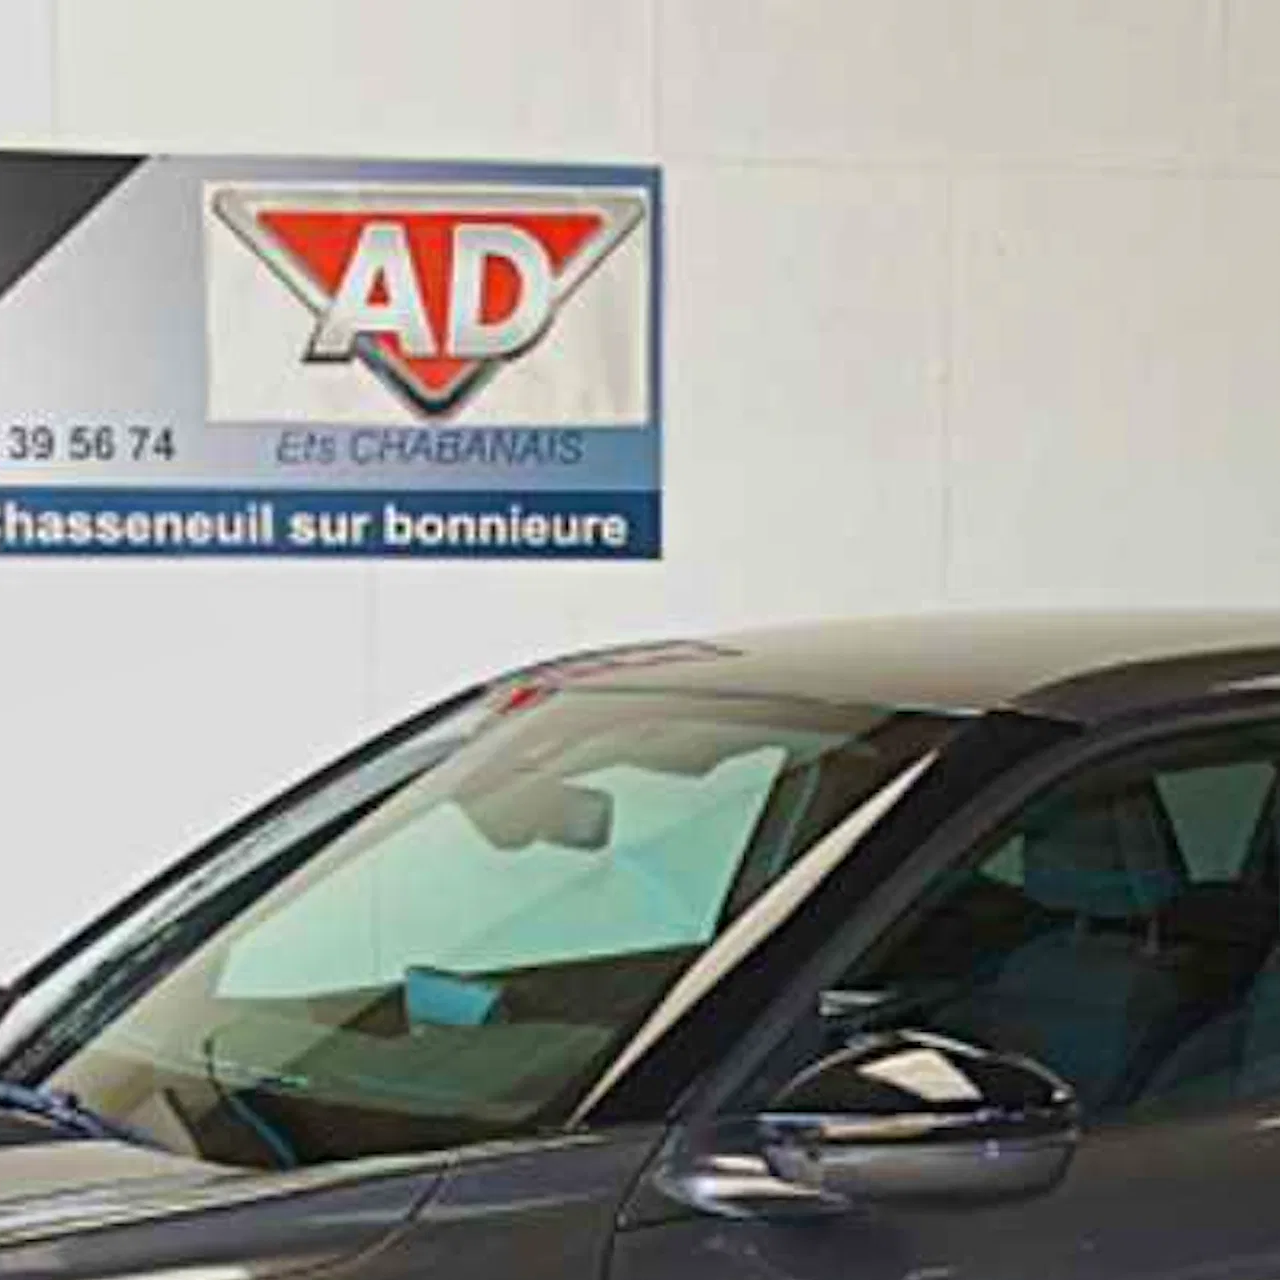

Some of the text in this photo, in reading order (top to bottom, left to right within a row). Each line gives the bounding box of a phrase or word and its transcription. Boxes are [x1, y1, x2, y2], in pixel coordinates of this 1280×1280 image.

[302, 221, 558, 363] AD
[7, 428, 55, 462] 39
[67, 428, 115, 462] 56
[127, 428, 176, 462] 74
[277, 430, 586, 467] Ets CHABANAIS
[289, 511, 370, 546] sur
[382, 505, 629, 548] bonnieure
